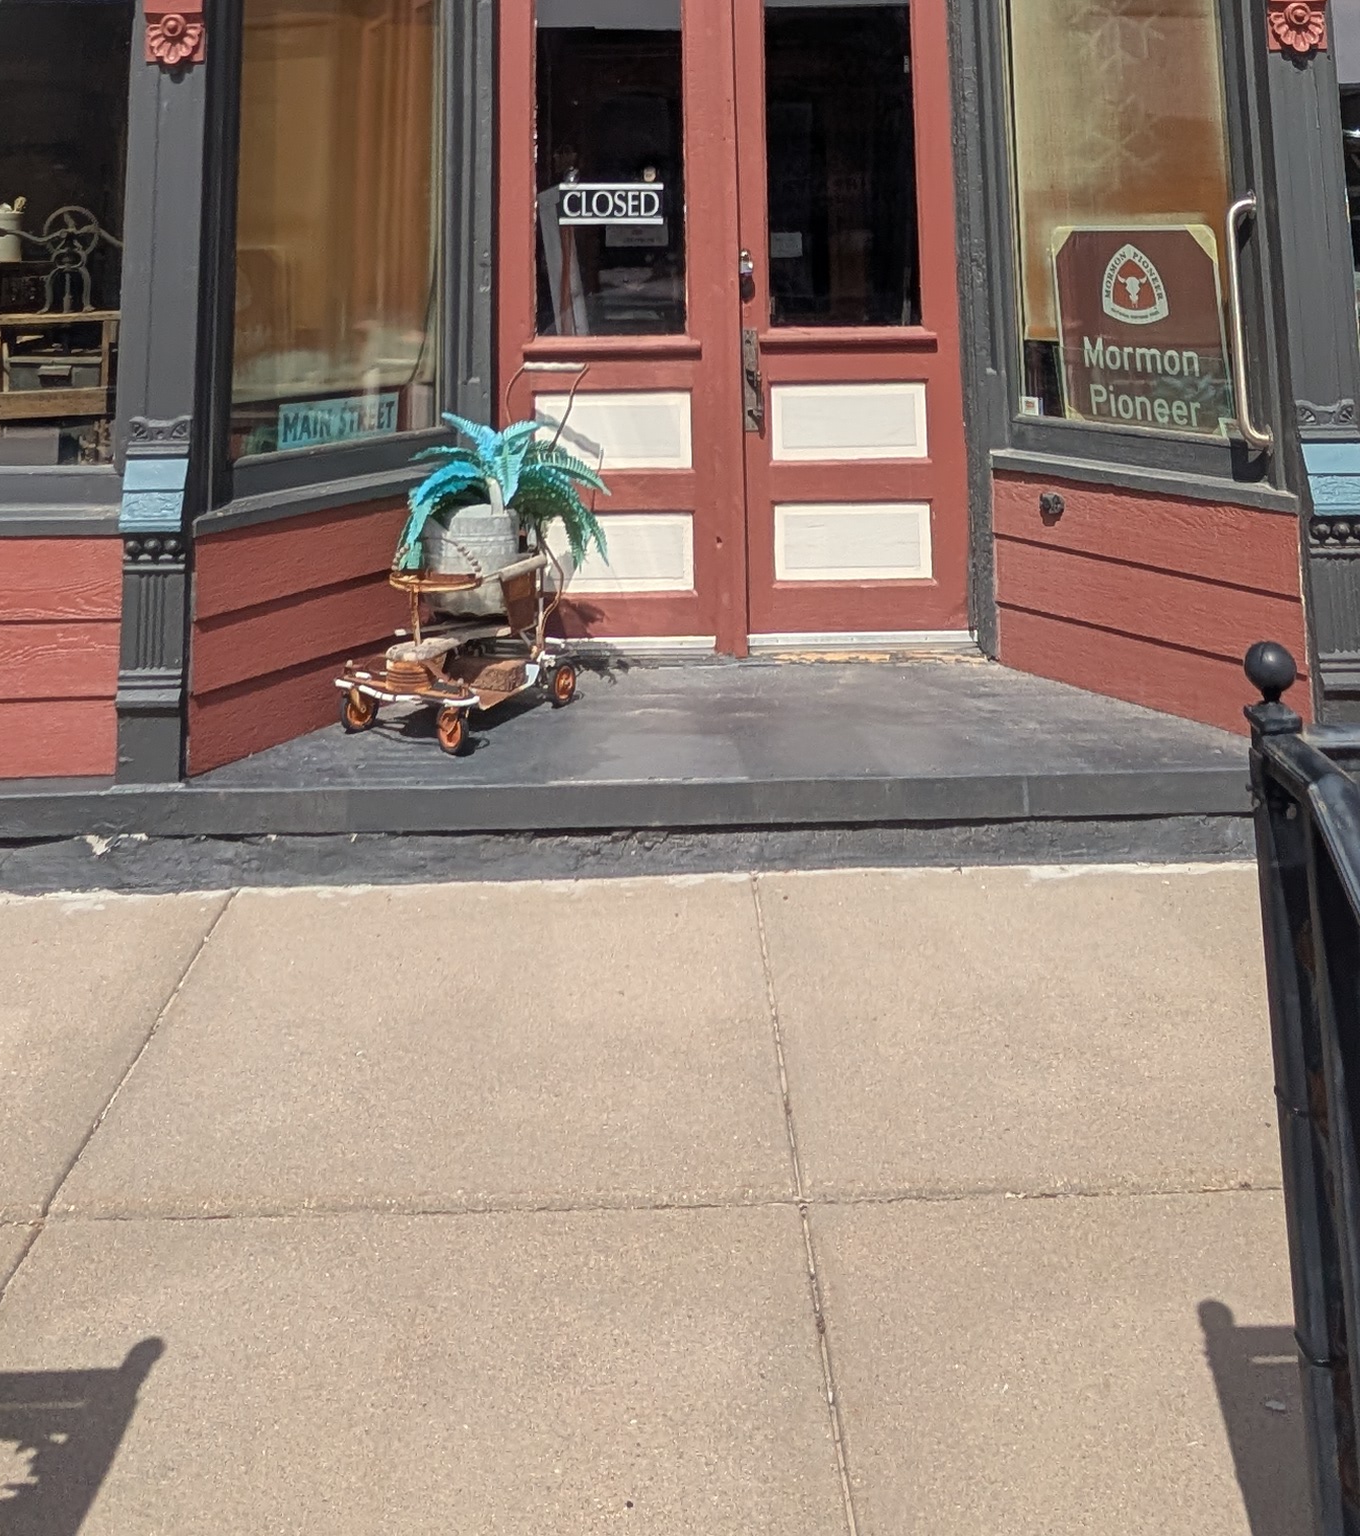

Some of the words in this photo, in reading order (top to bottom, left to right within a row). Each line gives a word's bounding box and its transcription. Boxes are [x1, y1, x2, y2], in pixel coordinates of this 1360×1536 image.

[563, 190, 660, 218] CLOSED
[1104, 250, 1128, 299] MORMON
[1132, 251, 1164, 301] PIONEER
[1083, 335, 1201, 378] Mormon
[282, 410, 333, 443] MAIN
[1090, 383, 1202, 427] Pioneer
